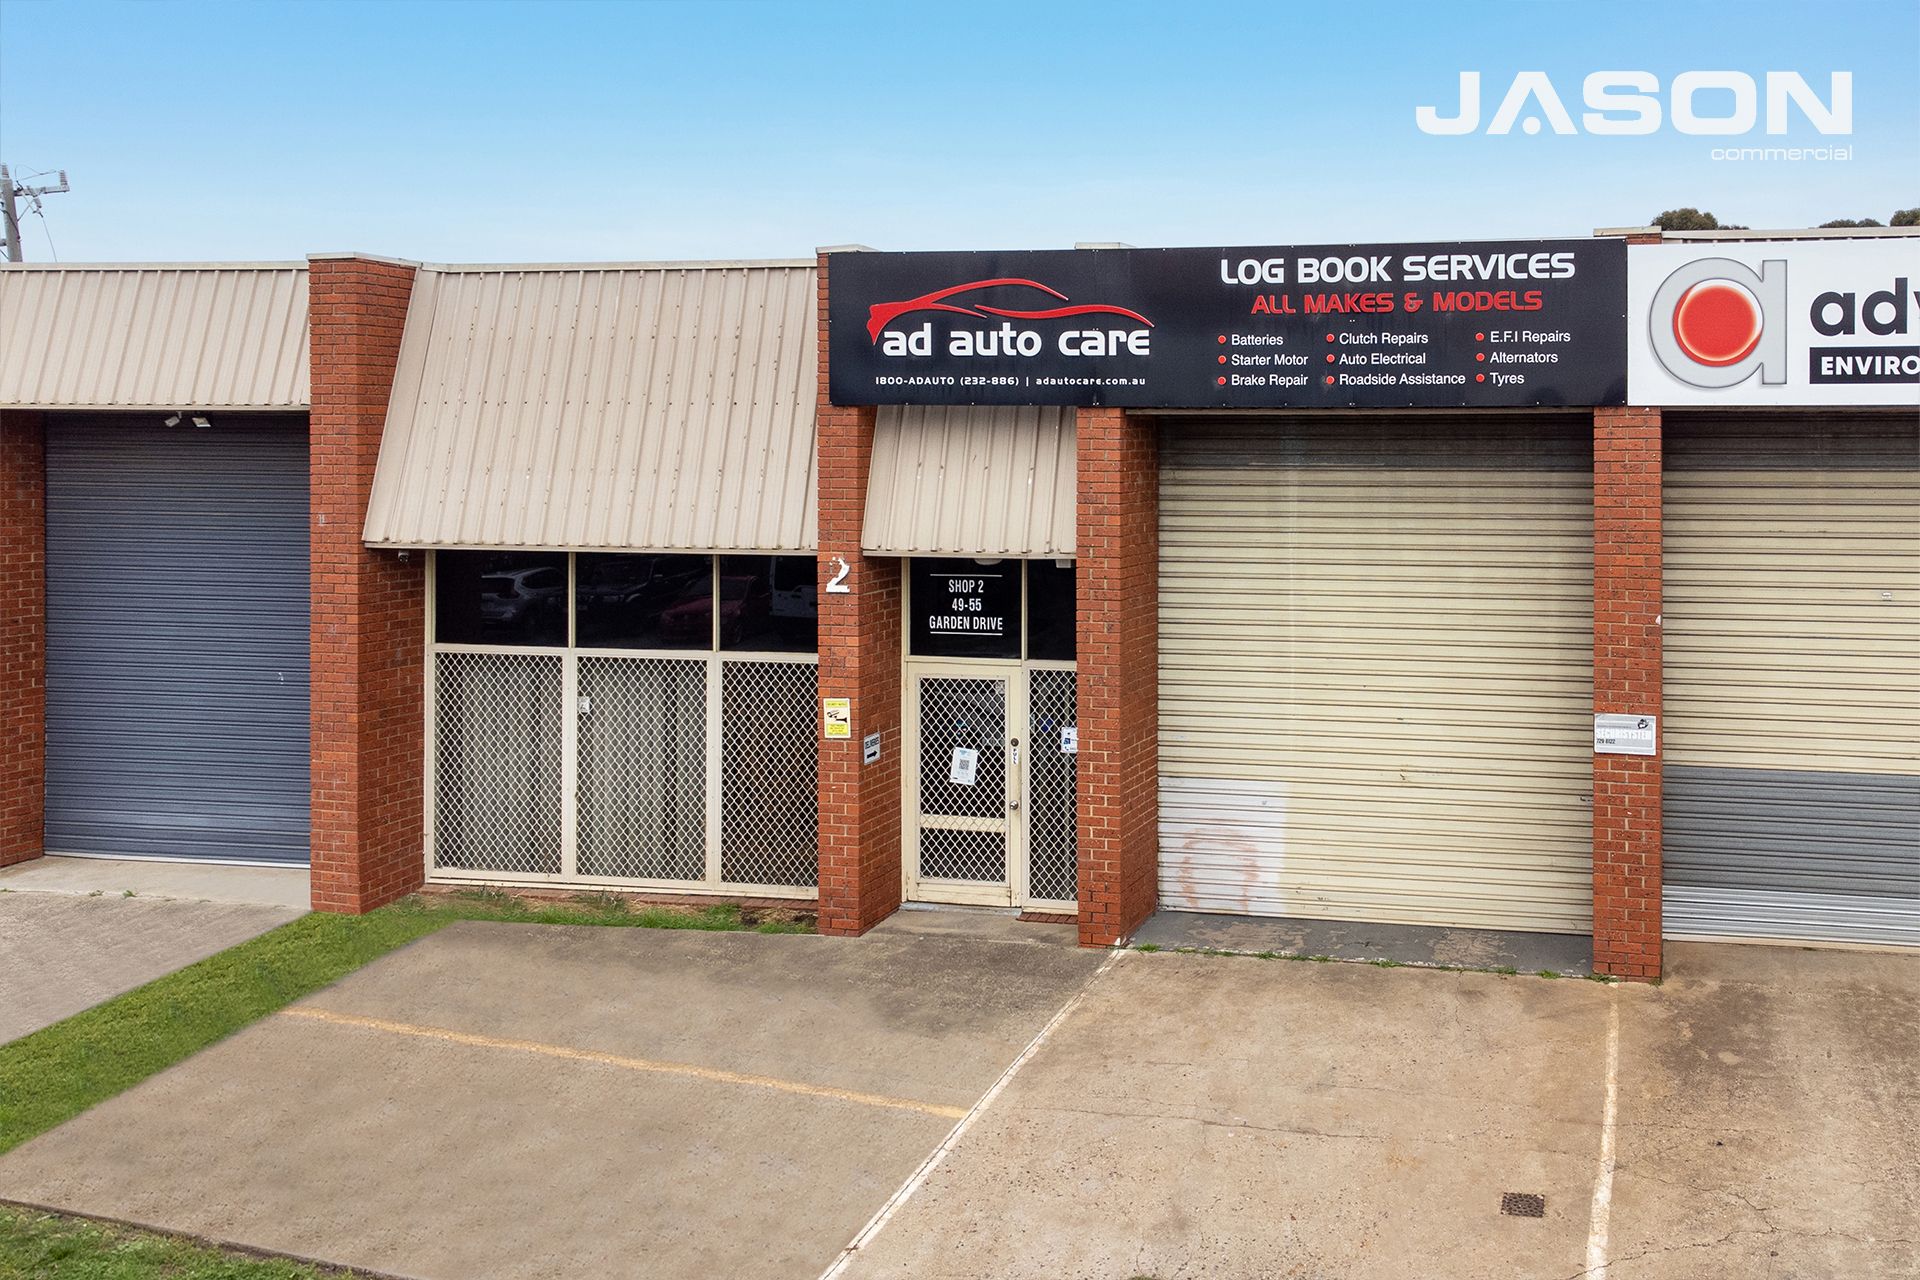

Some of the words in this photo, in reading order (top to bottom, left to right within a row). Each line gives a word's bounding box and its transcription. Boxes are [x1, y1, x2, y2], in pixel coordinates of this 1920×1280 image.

[1221, 258, 1284, 285] LOG
[1298, 256, 1392, 283] BOOK
[1403, 252, 1575, 282] SERVICES
[1251, 295, 1296, 314] ALL
[1305, 293, 1394, 314] MAKES
[1404, 293, 1422, 312] &
[1433, 291, 1542, 312] MODELS
[1810, 278, 1920, 336] ad
[883, 323, 931, 356] ad
[949, 323, 1042, 356] auto
[1058, 330, 1149, 356] care
[1231, 334, 1283, 346] Batteries
[1339, 332, 1377, 345] Clutch
[1382, 332, 1428, 346] Repairs
[1491, 331, 1518, 343] E.F.I
[1522, 330, 1571, 344] Repairs
[1231, 354, 1271, 366] Starter
[1275, 353, 1308, 365] Motor
[1339, 353, 1368, 365] Auto
[1371, 352, 1426, 364] Electrical
[1490, 351, 1558, 363] Alternators
[875, 377, 955, 385] 1800-ADAUTO
[960, 376, 1019, 386] (232-886)
[1036, 377, 1145, 385] adautocare.com.au
[1231, 374, 1266, 386] Brake
[1269, 374, 1308, 388] Repair
[1339, 373, 1397, 385] Roadside
[1399, 373, 1465, 385] Assistance
[1490, 372, 1524, 386] Tyres
[826, 557, 850, 593] 2
[949, 580, 975, 593] SHOP
[978, 580, 984, 593] 2
[952, 599, 982, 612] 49-55
[929, 616, 969, 630] GARDEN
[973, 617, 1003, 630] DRIVE
